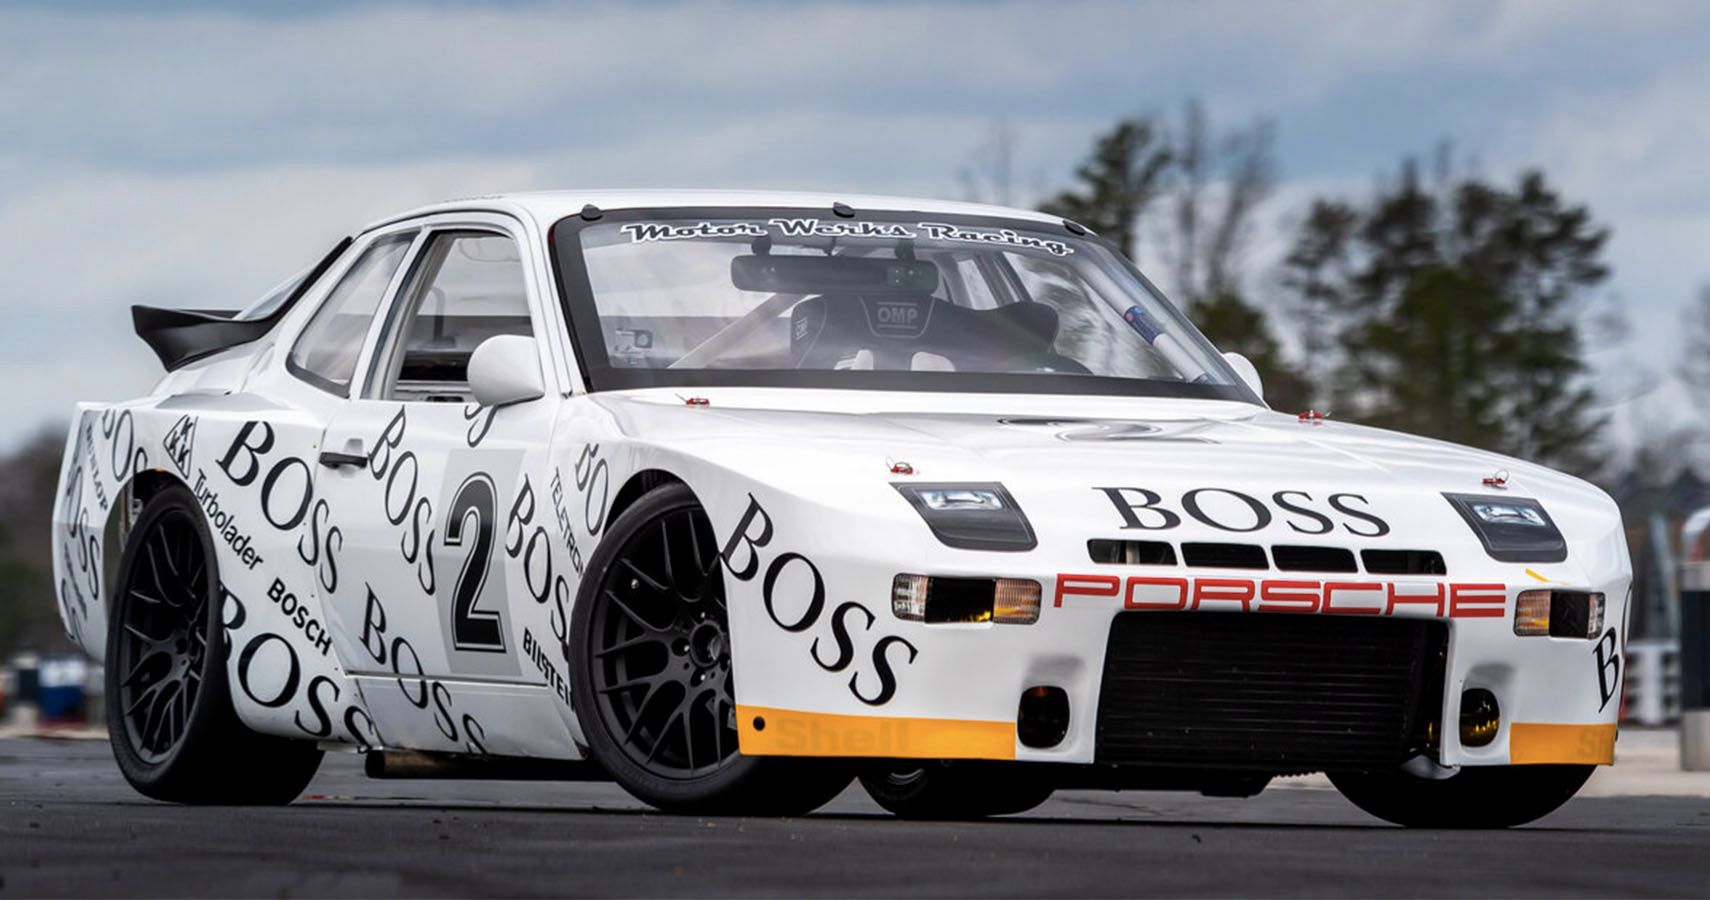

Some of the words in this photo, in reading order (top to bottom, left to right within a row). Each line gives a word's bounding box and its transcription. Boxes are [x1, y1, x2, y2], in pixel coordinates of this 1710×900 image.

[620, 222, 769, 243] Motor
[918, 222, 1074, 256] Racing
[877, 306, 918, 324] OMP
[193, 467, 265, 571] Turbolader
[215, 420, 343, 594] BOSS
[1091, 486, 1391, 538] BOSS
[443, 471, 507, 654] 2
[1053, 572, 1507, 618] PORSCHE
[267, 577, 332, 656] BOSCH
[720, 492, 919, 707] BOSS
[775, 716, 911, 753] Shell
